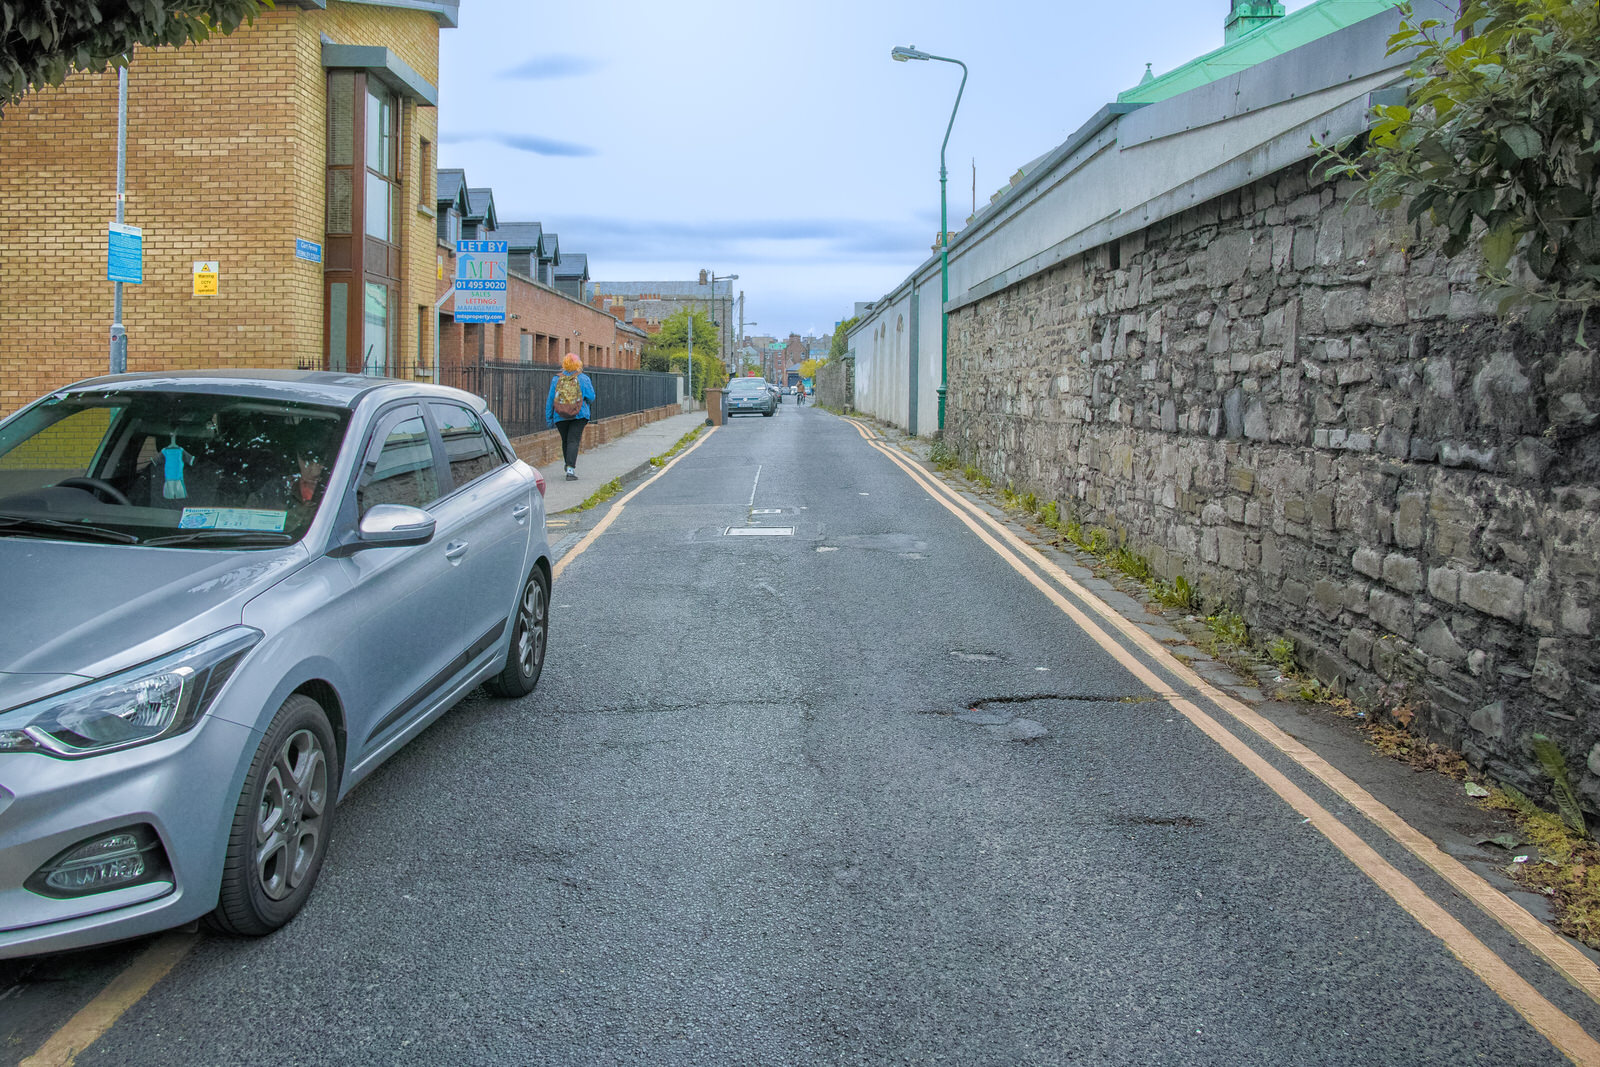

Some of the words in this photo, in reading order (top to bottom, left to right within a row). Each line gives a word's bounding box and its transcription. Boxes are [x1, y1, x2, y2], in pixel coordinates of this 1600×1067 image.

[461, 242, 483, 251] LET
[488, 242, 504, 251] BY
[469, 261, 506, 279] MTS
[485, 281, 506, 289] 9020
